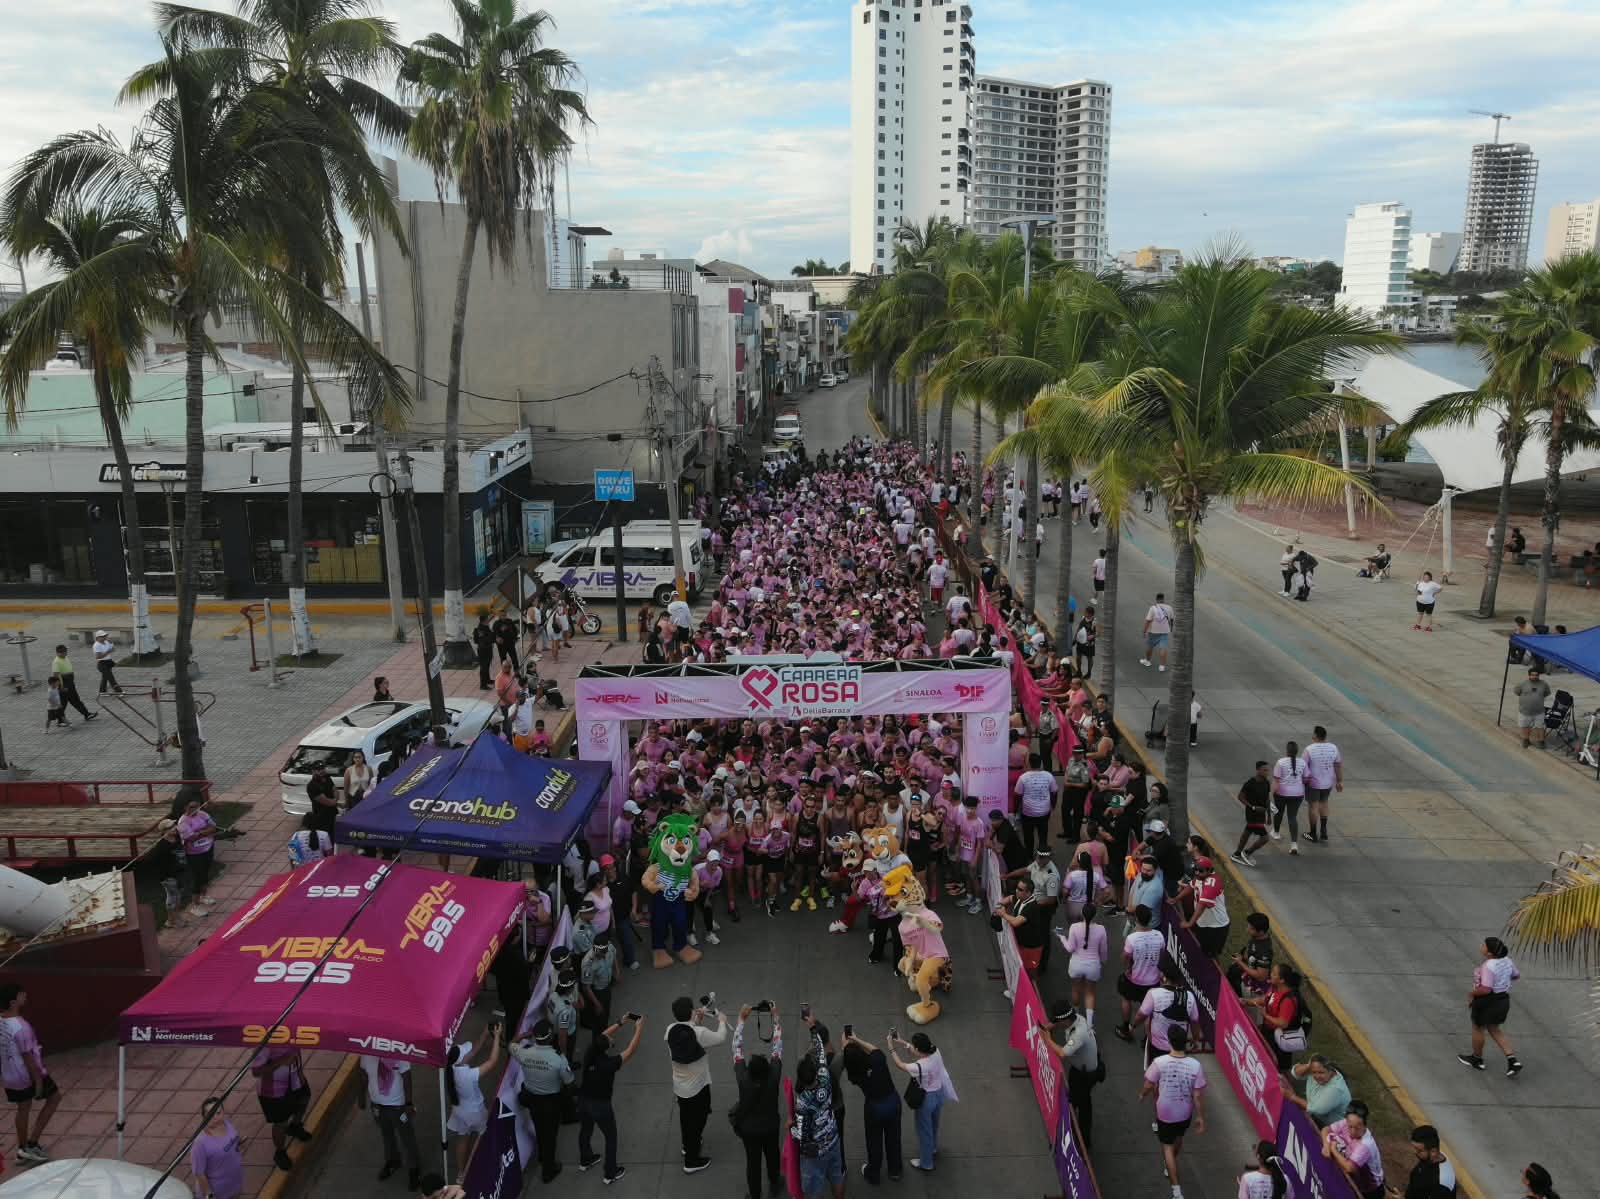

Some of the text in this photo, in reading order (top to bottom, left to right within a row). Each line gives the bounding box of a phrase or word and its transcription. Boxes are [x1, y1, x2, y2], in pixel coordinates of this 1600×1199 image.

[598, 476, 632, 484] DRIVE
[600, 485, 630, 494] THRU
[782, 669, 858, 682] CARRERA
[782, 682, 859, 704] ROSA
[905, 689, 943, 697] SINALOA
[959, 685, 985, 698] DIF
[586, 694, 640, 703] VIBRA
[307, 885, 361, 898] 99.5
[400, 880, 451, 949] VIBRA
[423, 899, 466, 953] 99.5
[240, 937, 386, 960] VIBRA
[352, 954, 384, 962] RADIO
[254, 961, 355, 985] 99.5
[242, 1025, 321, 1045] 99.5
[349, 1036, 428, 1055] VIBRA
